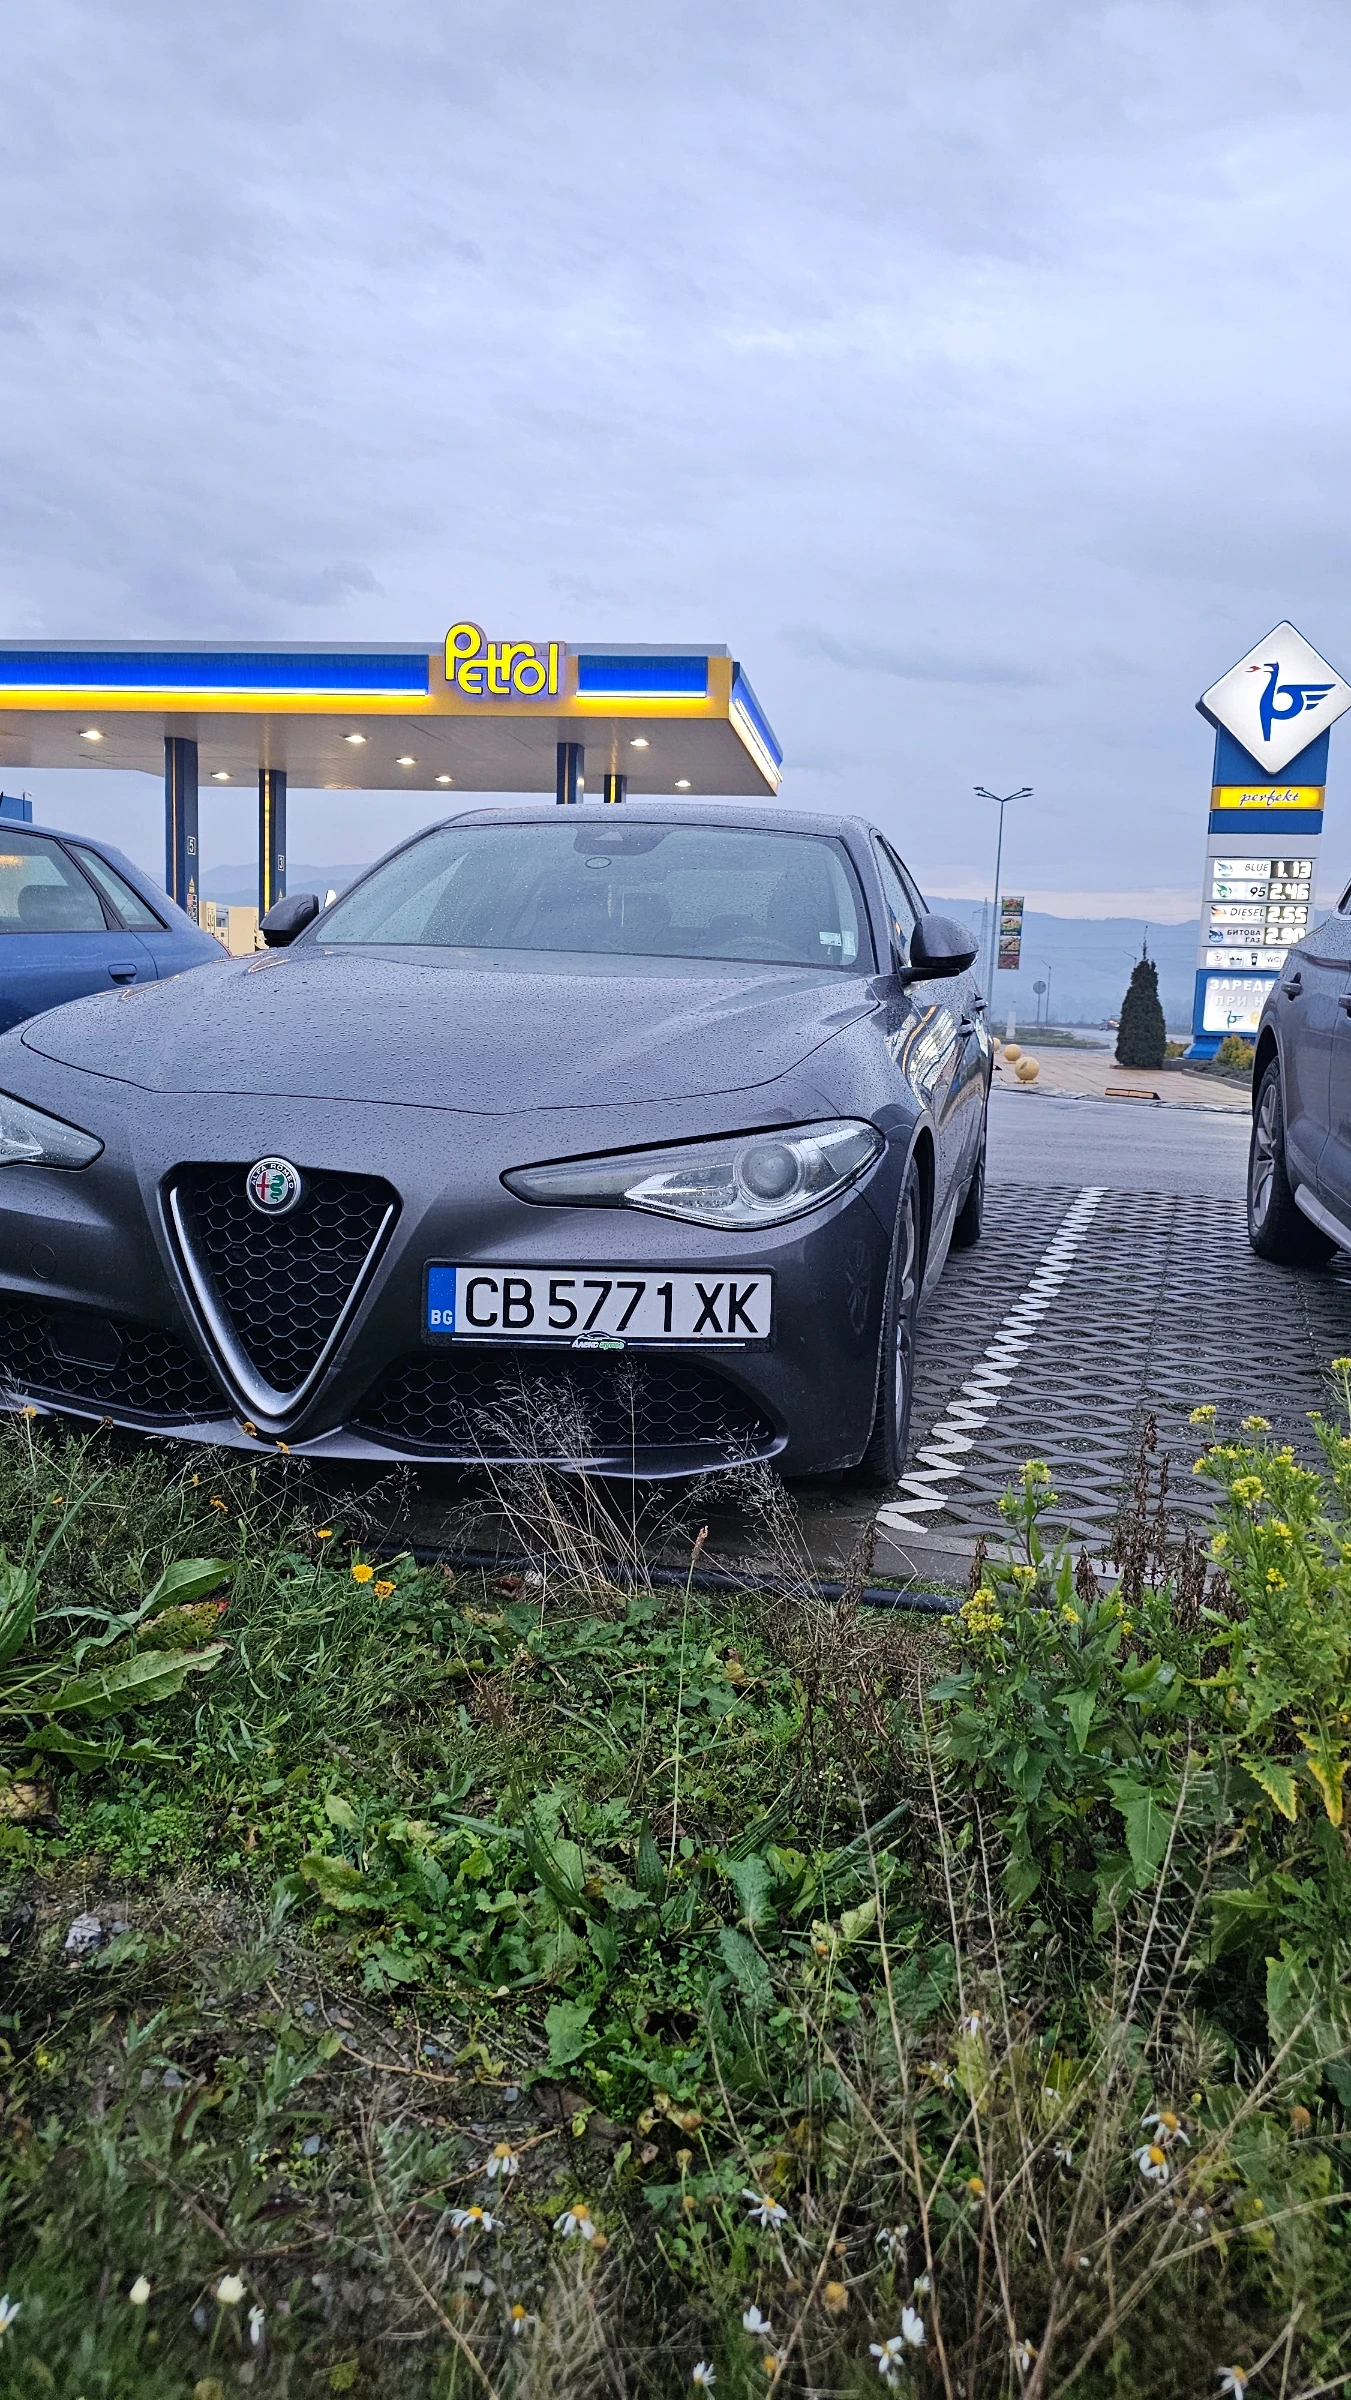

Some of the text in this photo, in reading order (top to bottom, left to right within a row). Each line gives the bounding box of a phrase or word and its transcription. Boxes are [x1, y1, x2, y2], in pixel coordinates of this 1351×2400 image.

[1239, 789, 1299, 806] perfekt
[1244, 861, 1312, 878] BLUE 1.13
[1250, 883, 1310, 900] 95 2.46
[1230, 906, 1308, 924] DIESEL 2.55
[1214, 995, 1248, 1007] ПРИ
[251, 1163, 294, 1189] ALFA ROMEO
[465, 1277, 759, 1333] CB 5771 XK
[430, 1309, 453, 1325] BG
